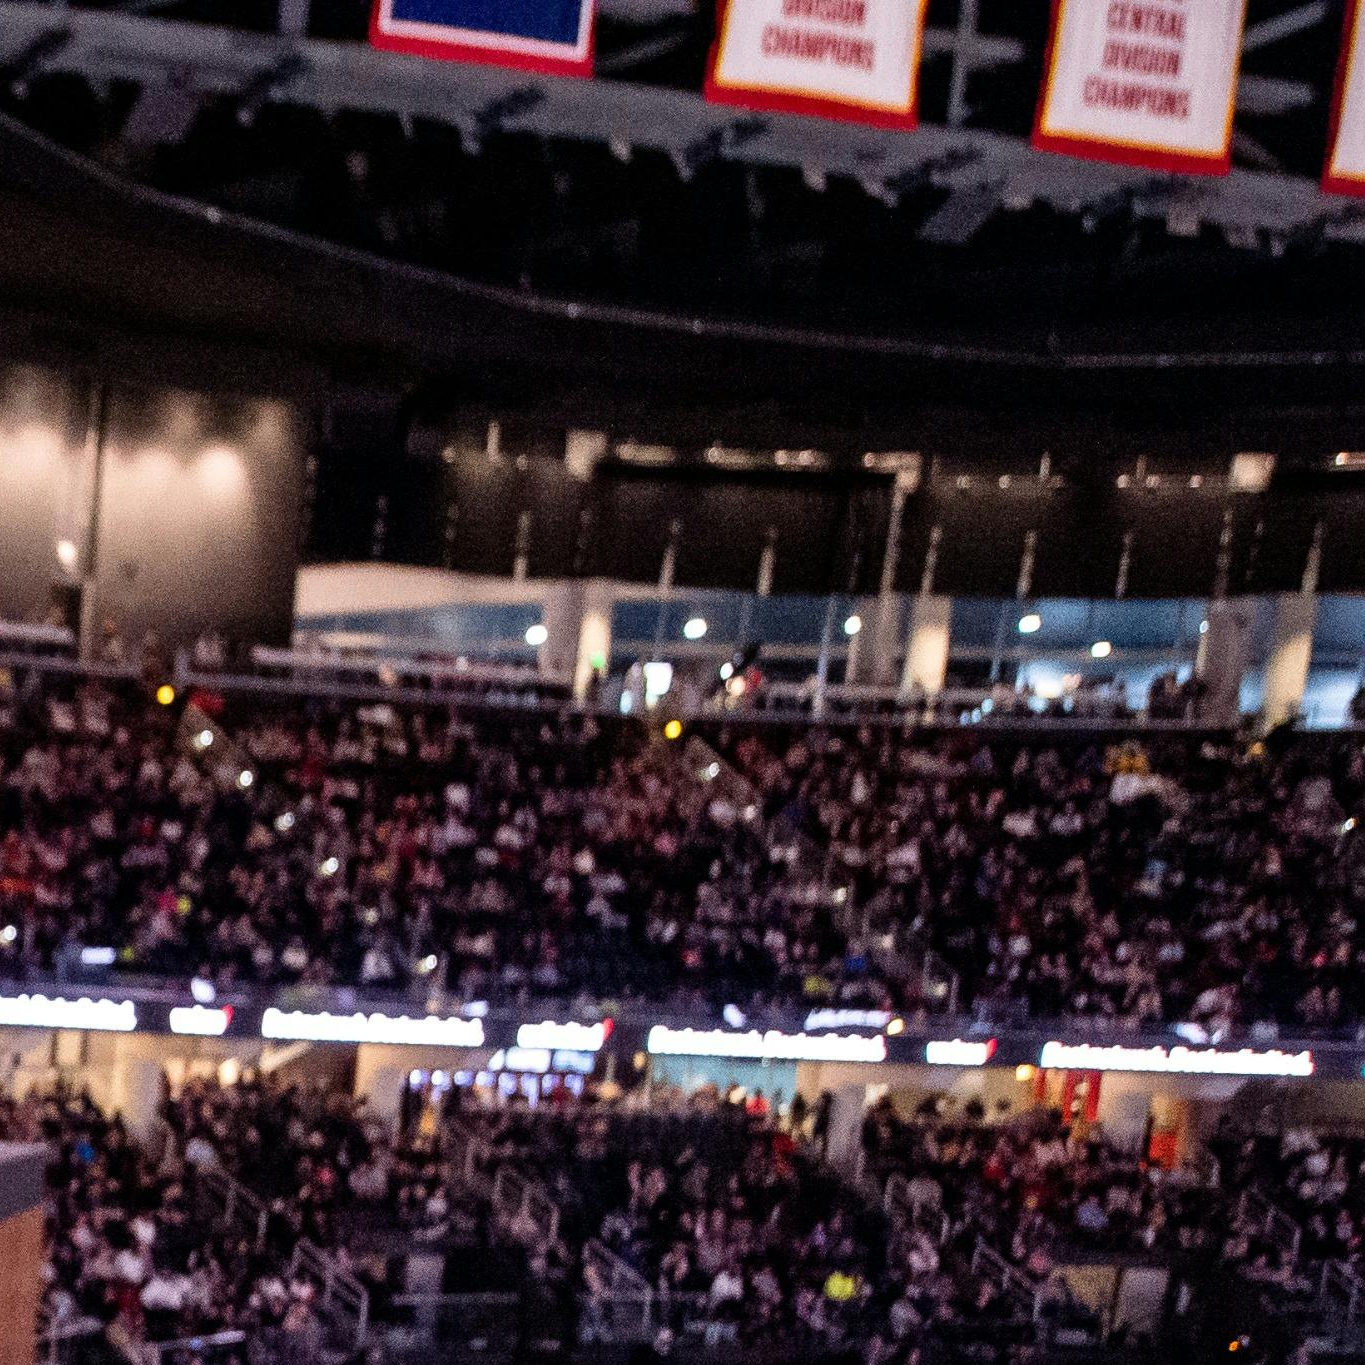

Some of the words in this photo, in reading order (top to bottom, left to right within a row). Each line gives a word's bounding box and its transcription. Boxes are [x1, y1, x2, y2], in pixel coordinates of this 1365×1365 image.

[1106, 1, 1186, 42] CENTRAL
[761, 25, 875, 72] CHAMPIONS
[1102, 39, 1180, 78] DIVISION
[1082, 75, 1190, 119] CHAMPIONS
